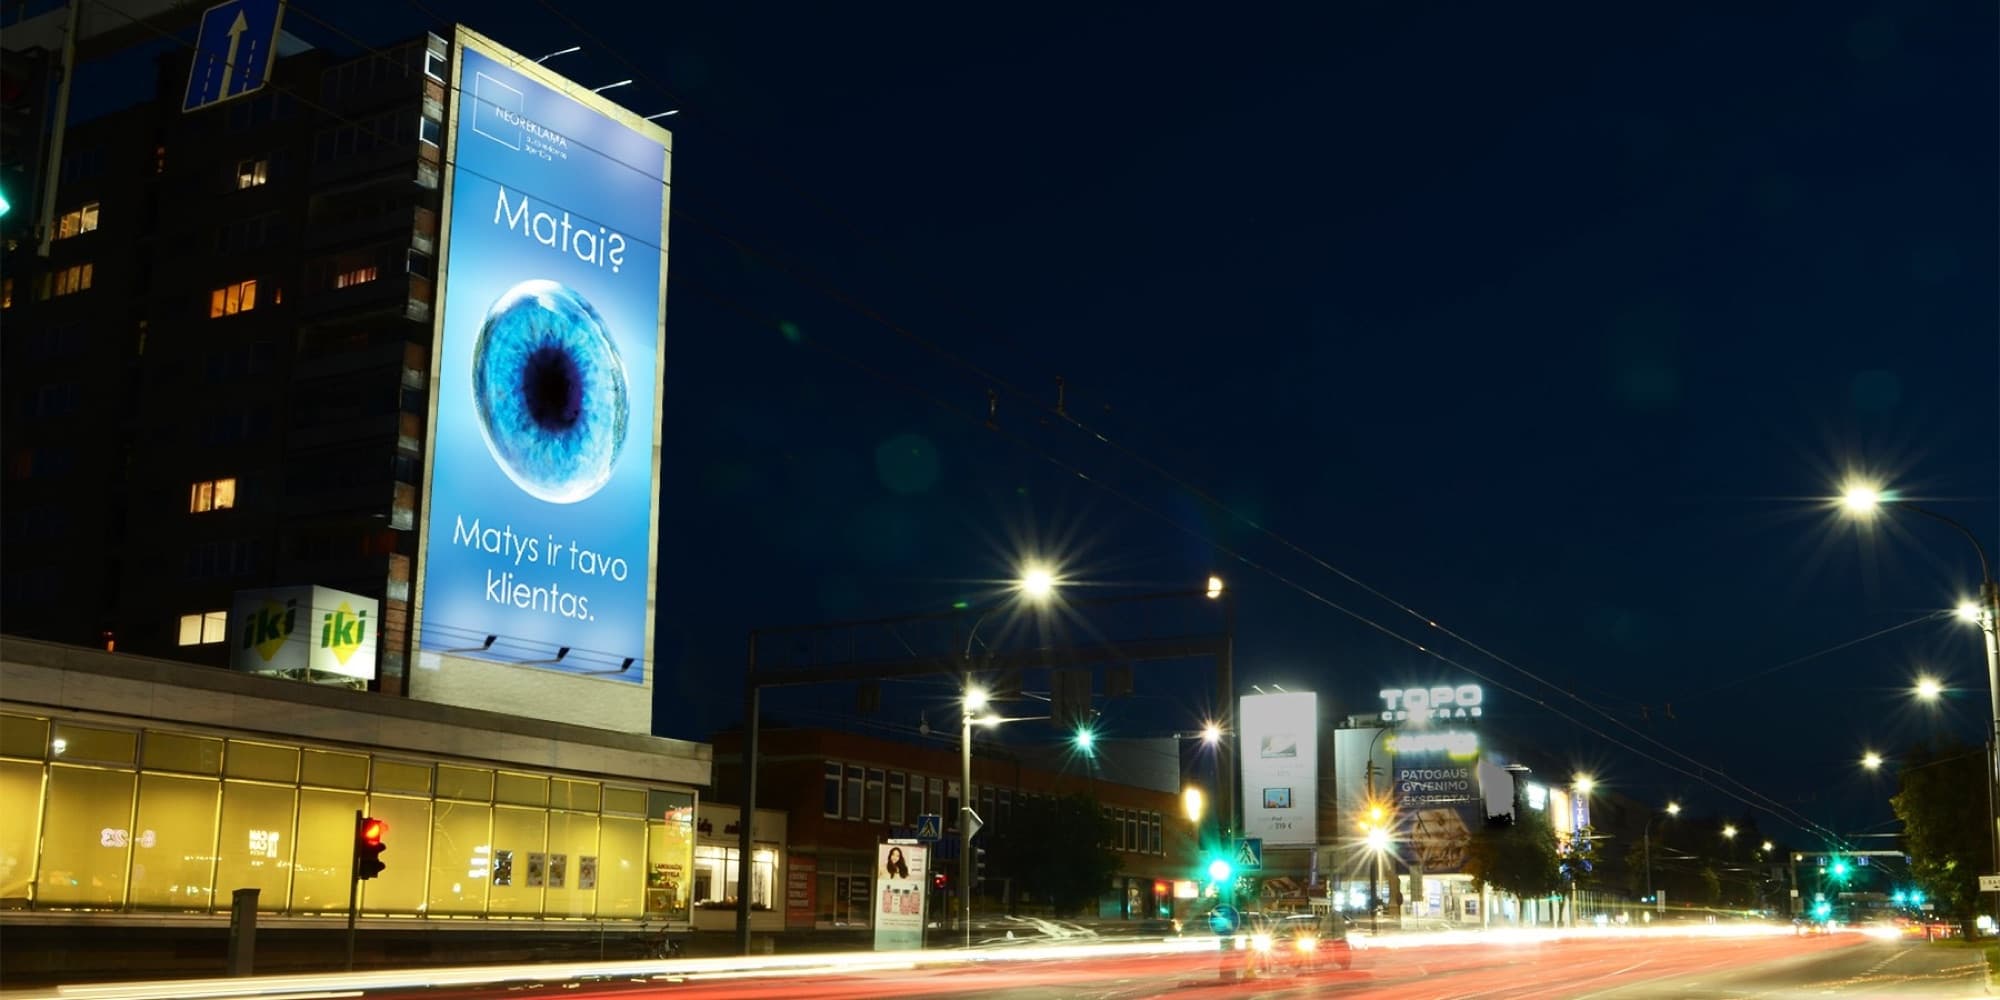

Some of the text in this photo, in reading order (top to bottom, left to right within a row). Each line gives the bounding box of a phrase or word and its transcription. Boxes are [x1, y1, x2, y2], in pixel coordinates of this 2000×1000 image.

[496, 106, 568, 149] NEOREKLAMA
[494, 184, 626, 273] Matai?
[453, 514, 628, 582] Matys ir tavo
[485, 569, 595, 622] klientas.
[244, 598, 297, 649] iki
[321, 610, 367, 648] iki
[1380, 684, 1482, 710] TOPO
[1401, 768, 1468, 780] PATOGAUS
[1402, 780, 1468, 792] GYVENIMO
